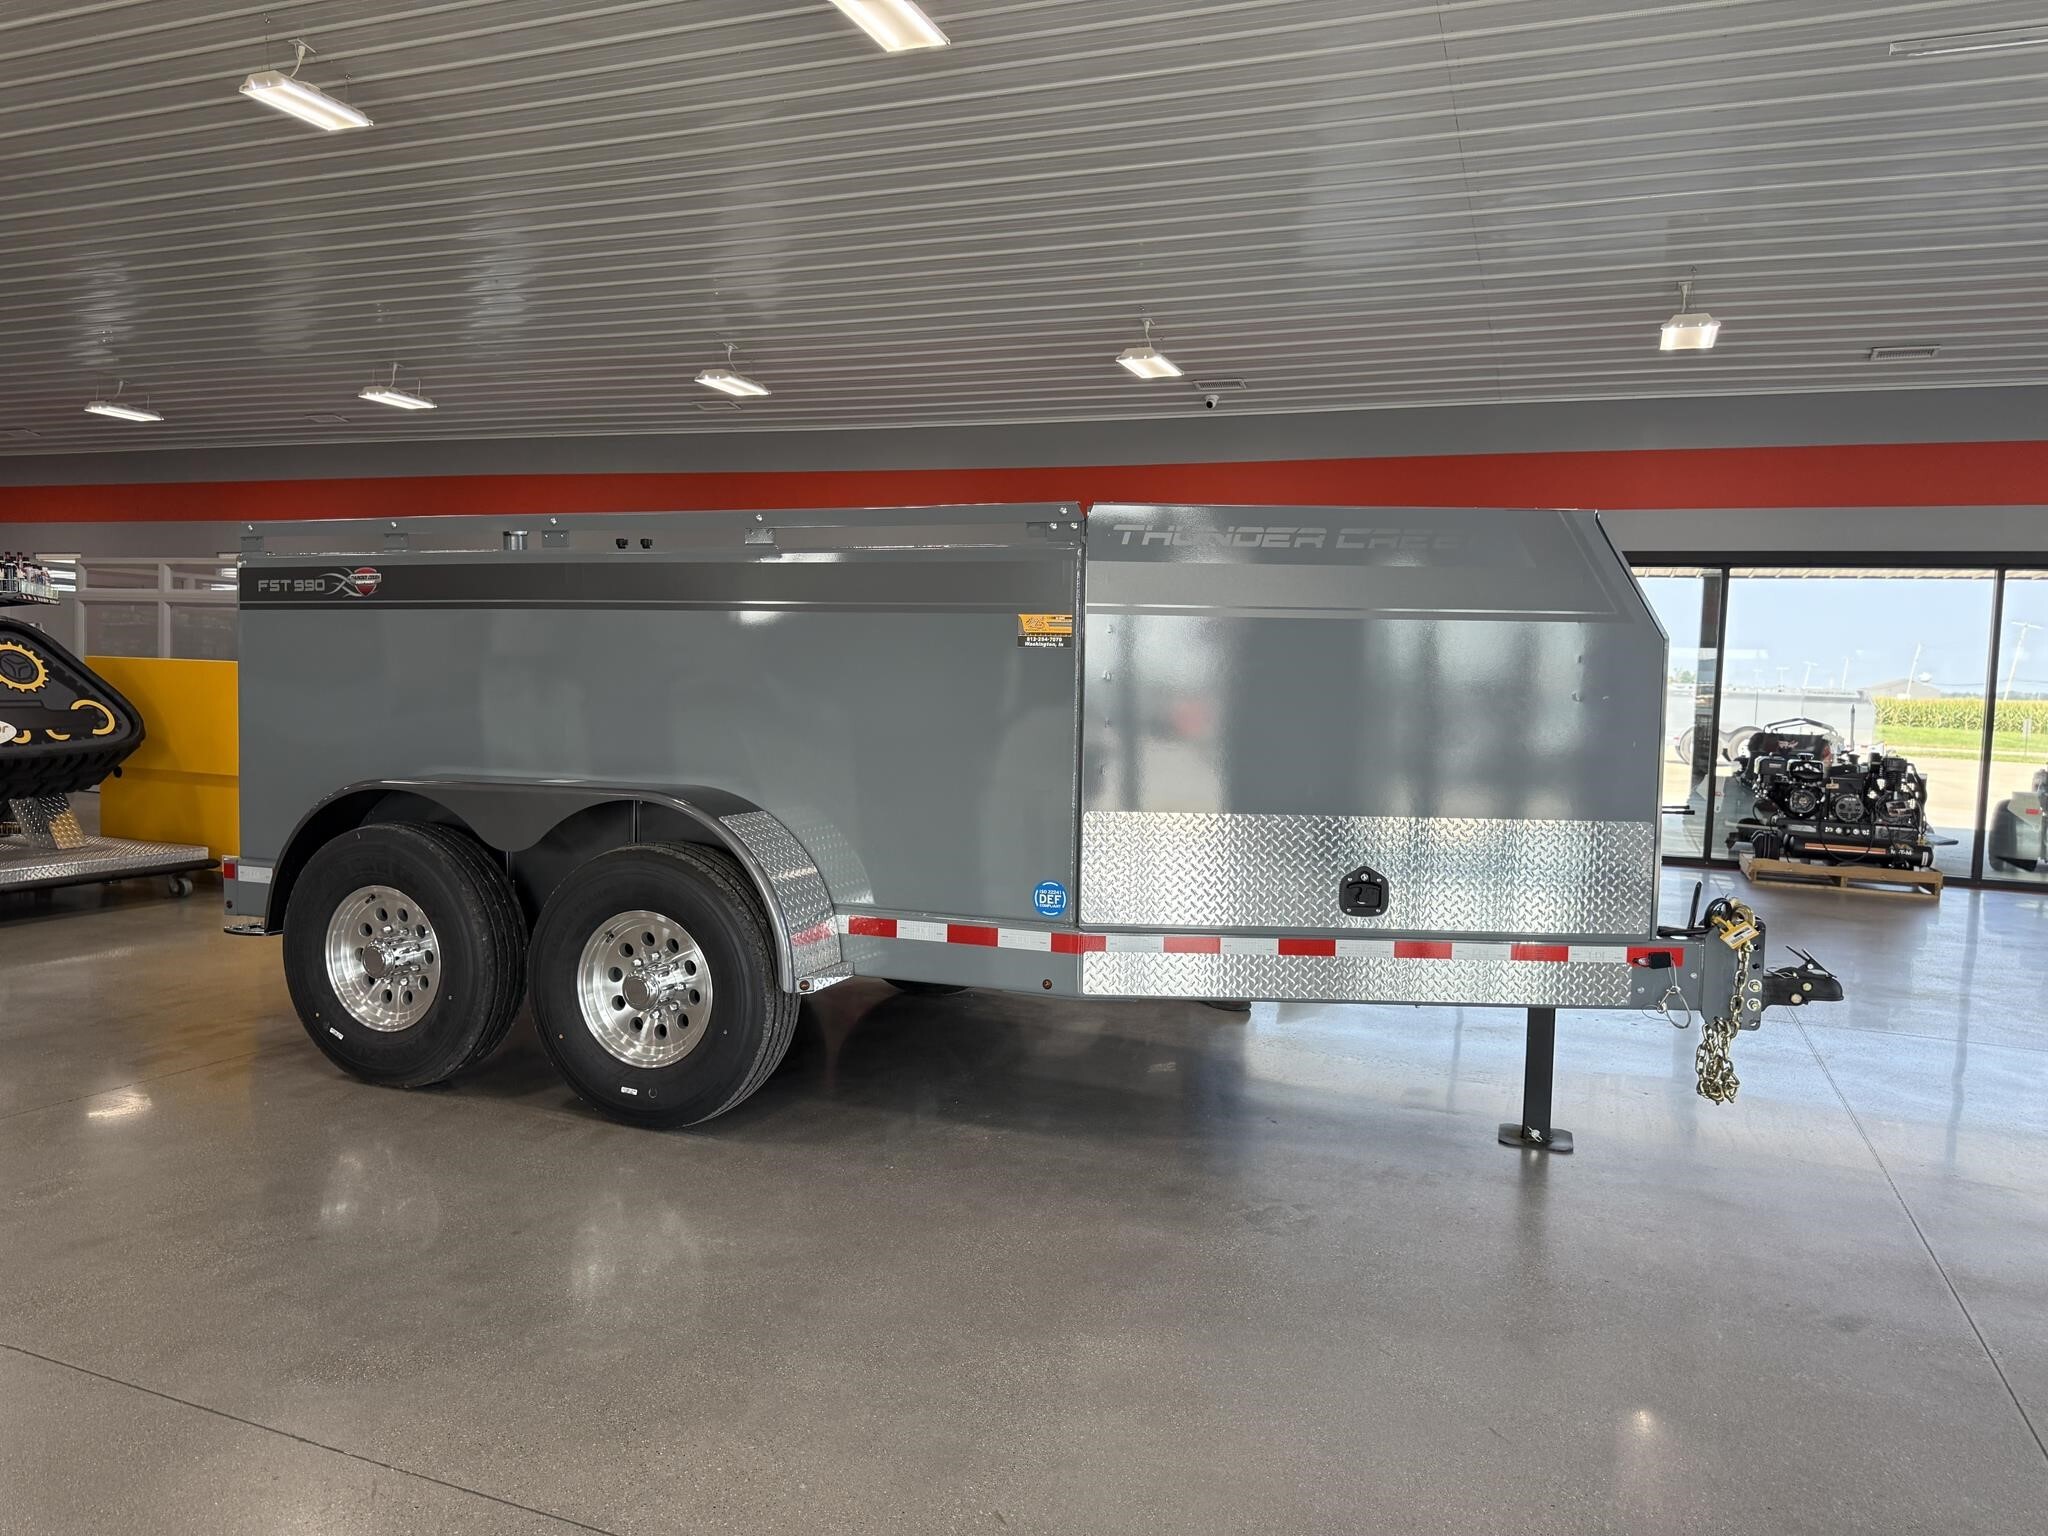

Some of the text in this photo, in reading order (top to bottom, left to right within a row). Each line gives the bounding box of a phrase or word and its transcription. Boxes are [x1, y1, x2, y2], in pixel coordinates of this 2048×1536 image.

[1113, 524, 1327, 549] THUNDER
[257, 579, 326, 592] FST 990
[1039, 894, 1062, 904] DEF
